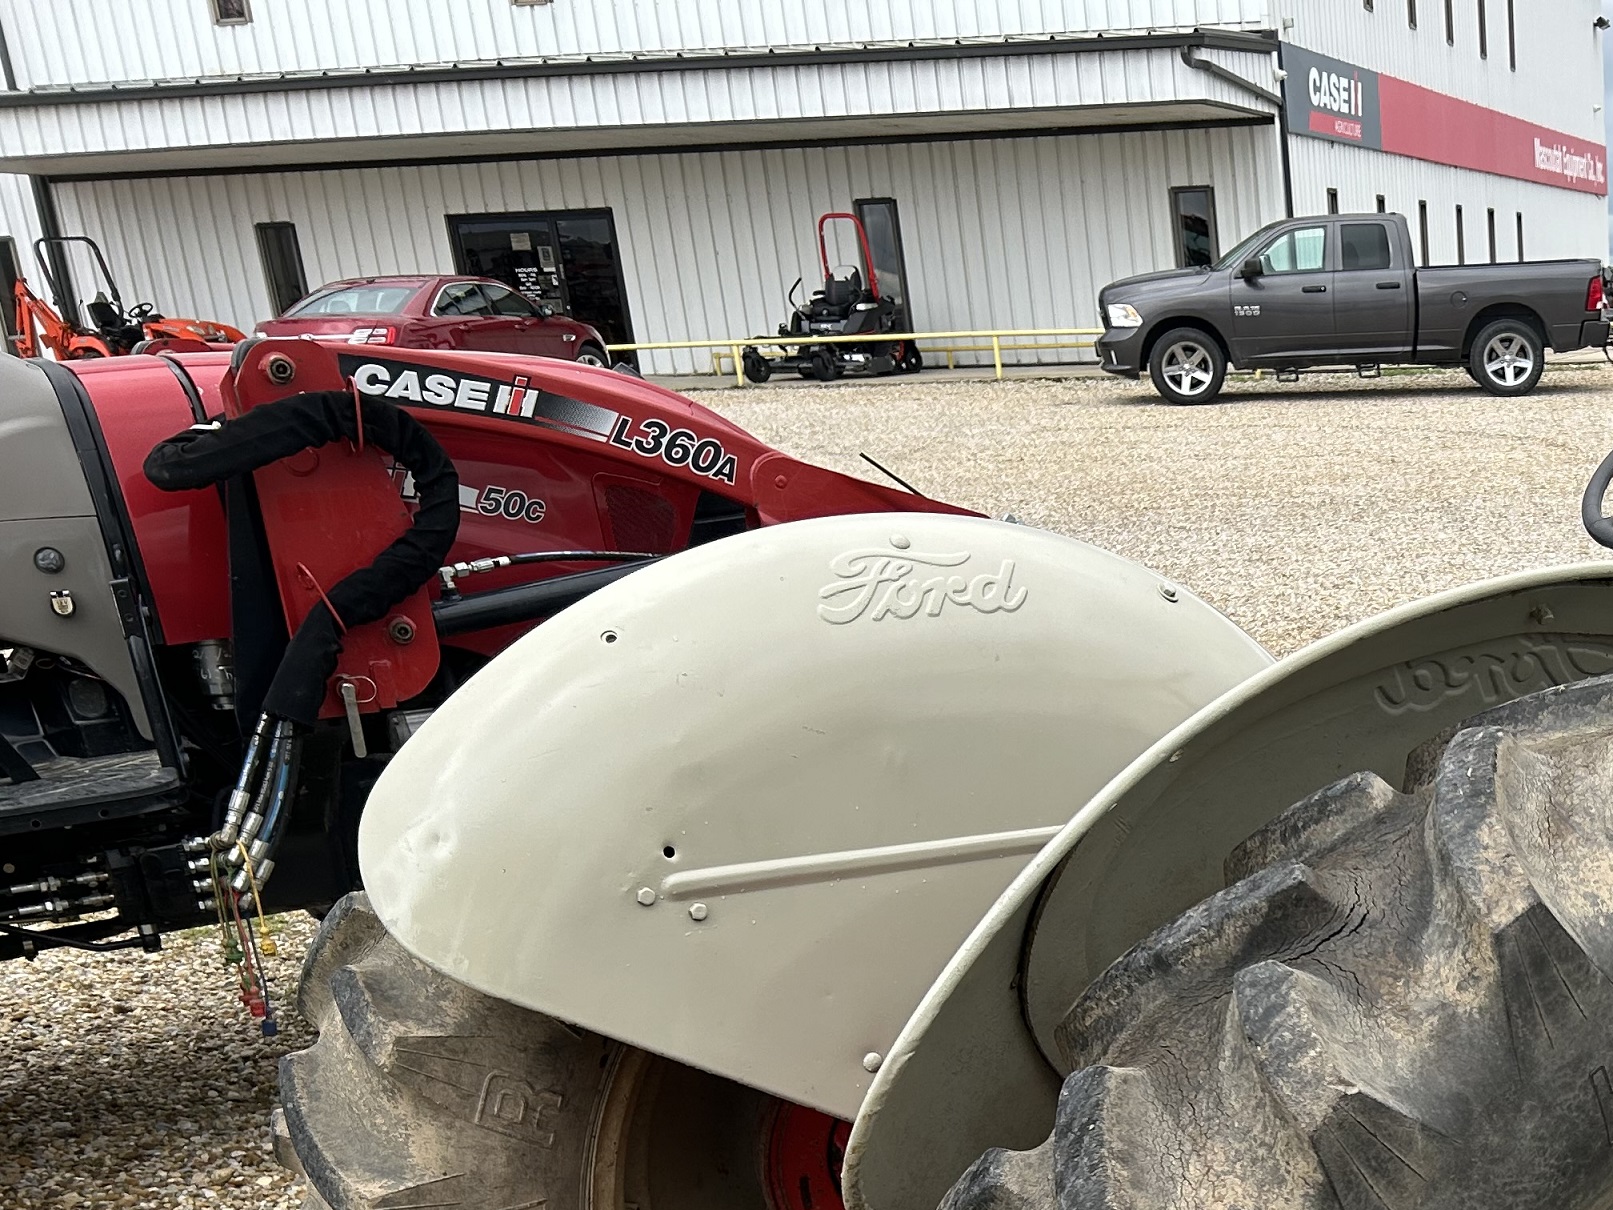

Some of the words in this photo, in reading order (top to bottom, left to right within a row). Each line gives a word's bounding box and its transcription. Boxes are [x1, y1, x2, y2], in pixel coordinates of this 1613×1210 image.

[1308, 66, 1349, 114] CASE
[515, 266, 539, 274] HOURS
[354, 363, 492, 411] CASE
[816, 548, 1029, 626] Ford
